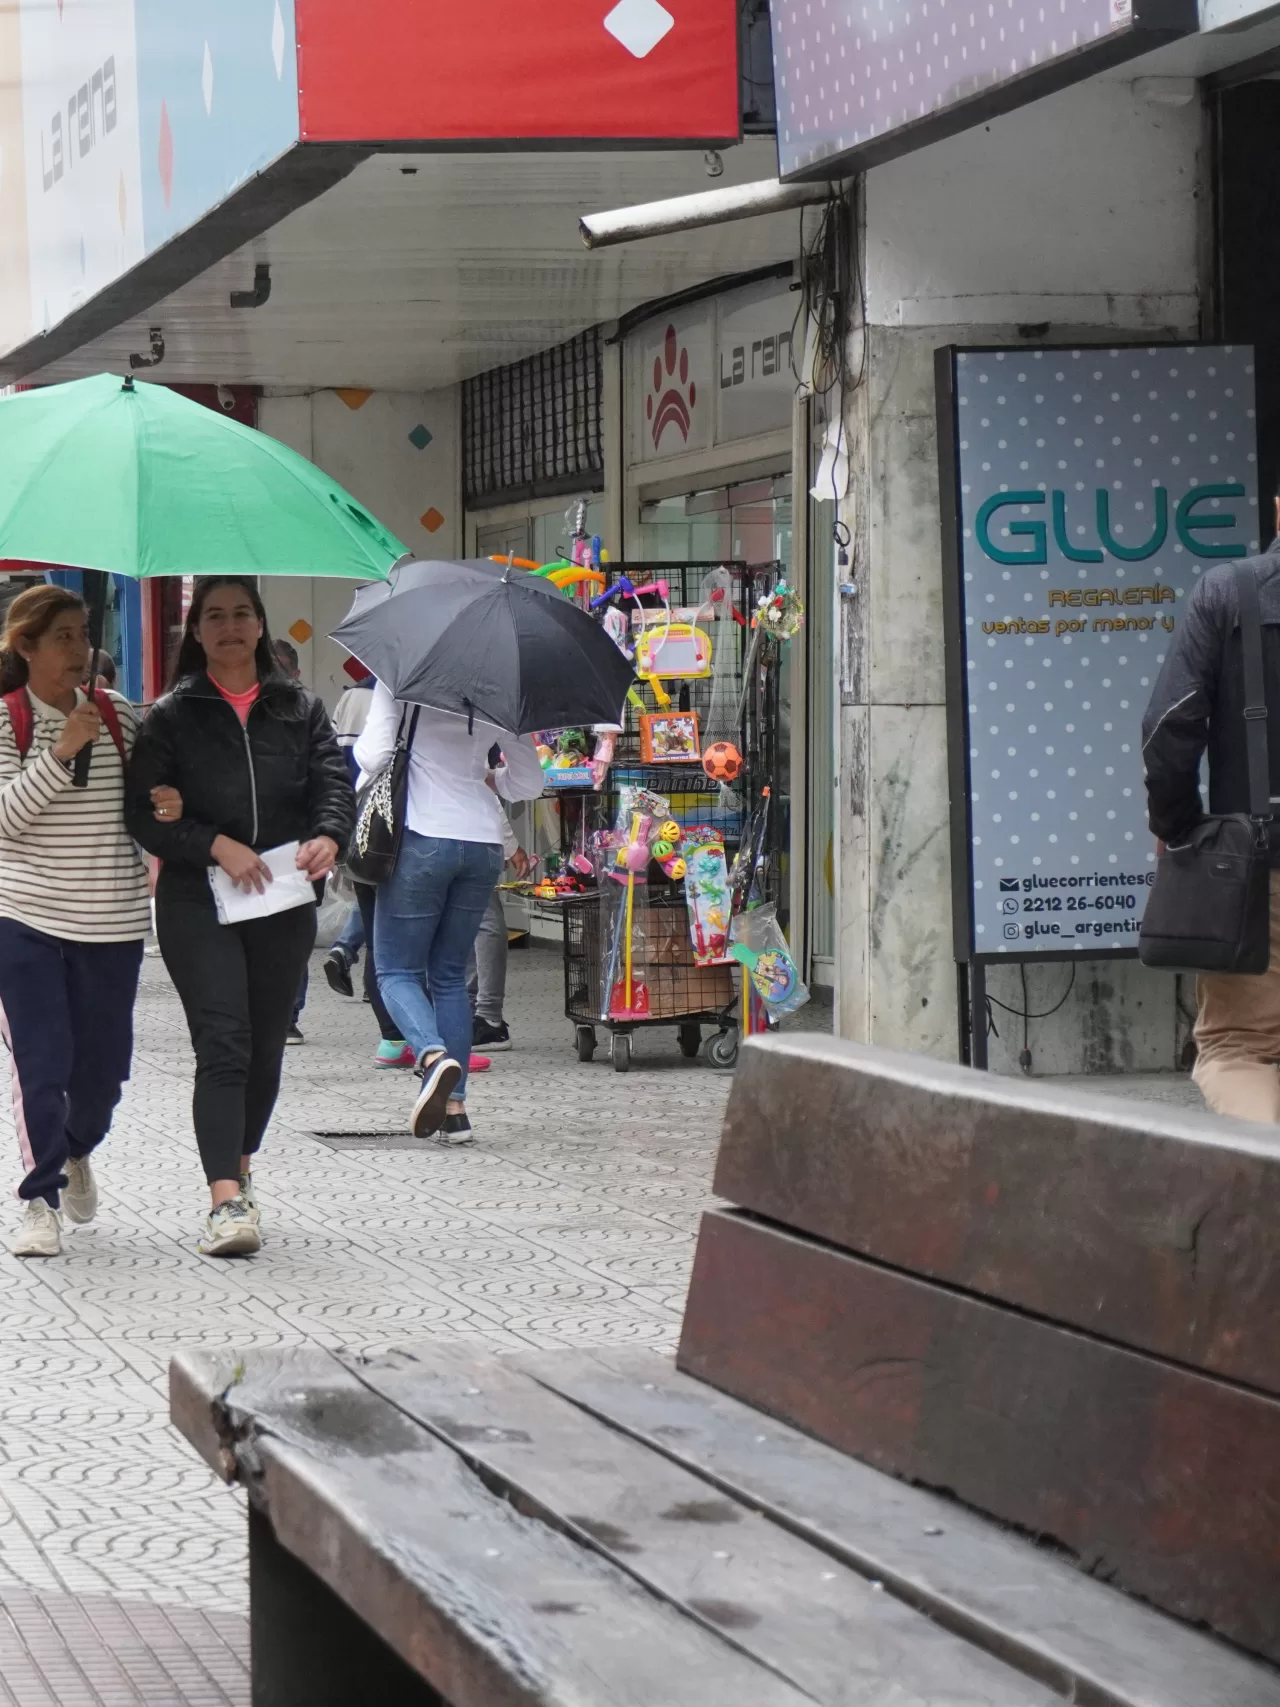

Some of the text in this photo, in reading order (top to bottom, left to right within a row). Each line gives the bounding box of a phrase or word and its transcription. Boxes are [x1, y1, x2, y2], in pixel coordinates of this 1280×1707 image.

[40, 54, 117, 193] La reina
[721, 346, 745, 389] La
[975, 483, 1247, 565] GLUE
[981, 615, 1175, 636] ventas por menor y
[1023, 895, 1136, 912] 2212 26-6040
